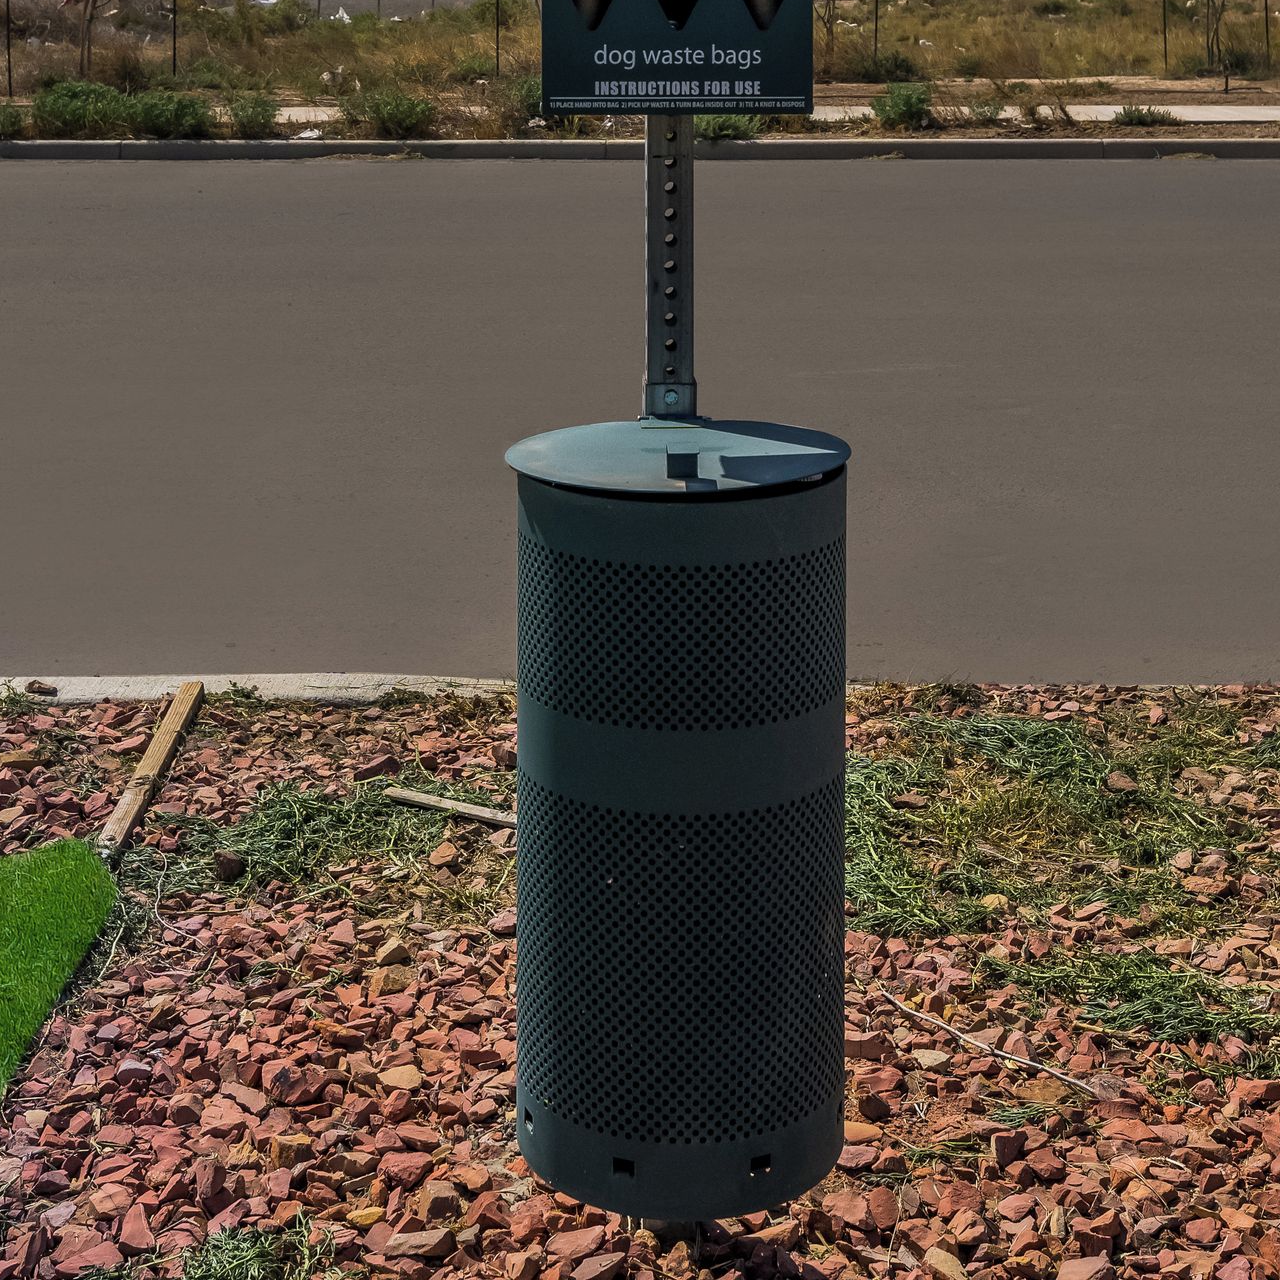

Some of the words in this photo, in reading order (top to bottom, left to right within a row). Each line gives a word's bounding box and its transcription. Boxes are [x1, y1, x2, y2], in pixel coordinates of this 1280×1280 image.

[594, 43, 636, 70] dog
[642, 47, 705, 65] waste
[711, 43, 762, 70] bags
[594, 81, 700, 96] INSTRUCTIONS
[704, 81, 730, 95] FOR
[734, 81, 761, 95] USE
